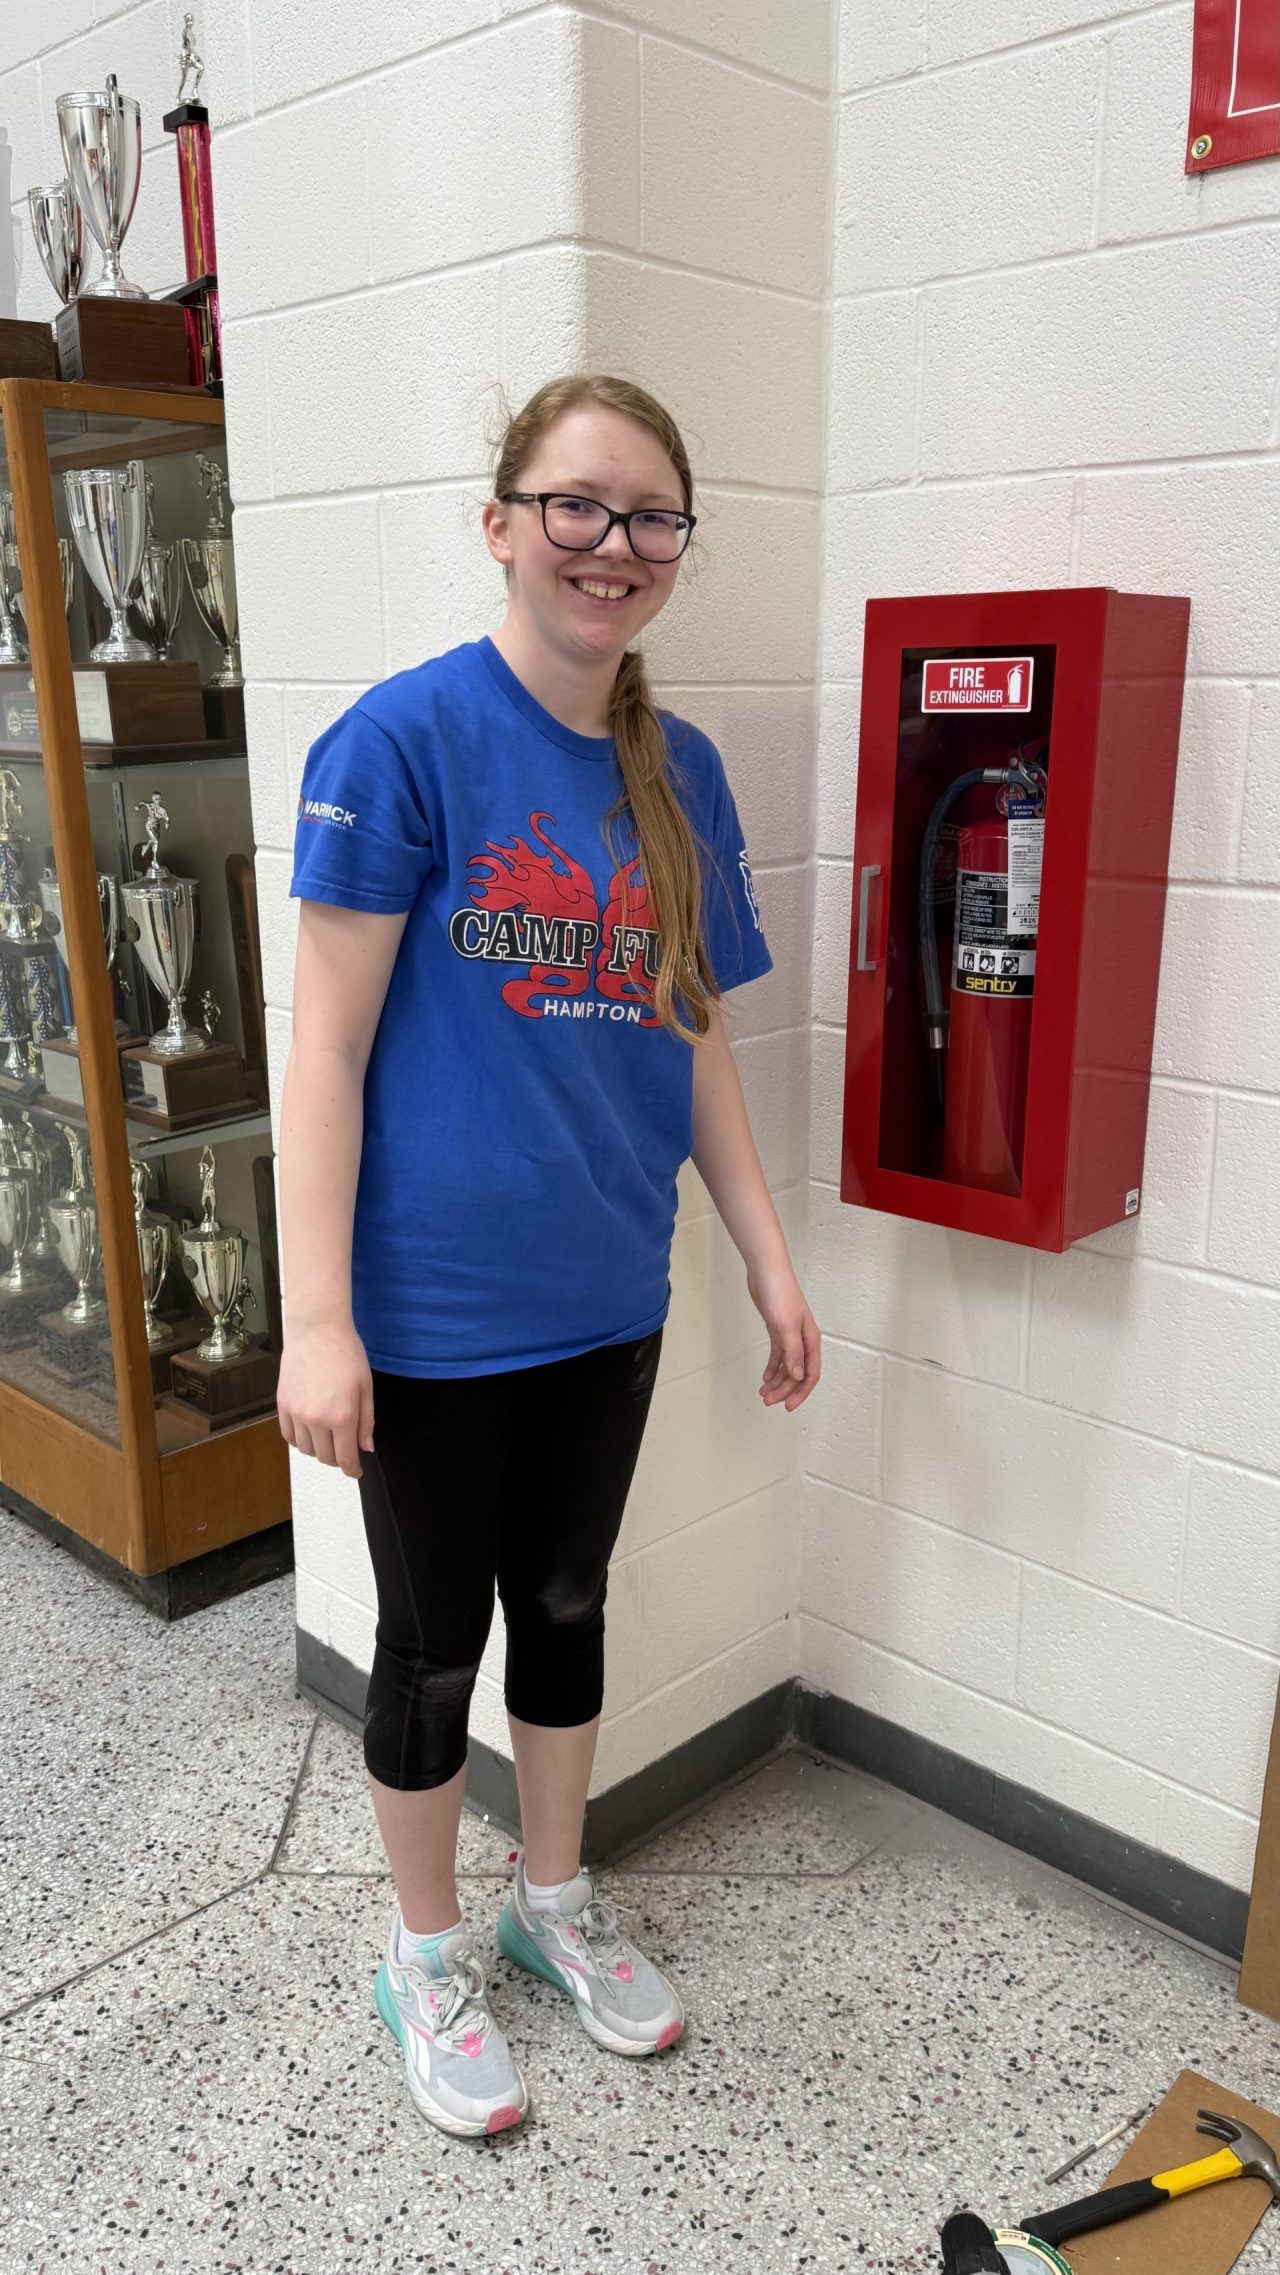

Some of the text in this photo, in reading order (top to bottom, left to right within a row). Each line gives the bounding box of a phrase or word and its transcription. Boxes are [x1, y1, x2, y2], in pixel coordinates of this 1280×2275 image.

[949, 667, 985, 688] FIRE
[929, 690, 1003, 704] EXTINGUISHER
[449, 909, 598, 967] CAMP
[965, 976, 1017, 993] sentry
[544, 999, 641, 1023] HAMPTON
